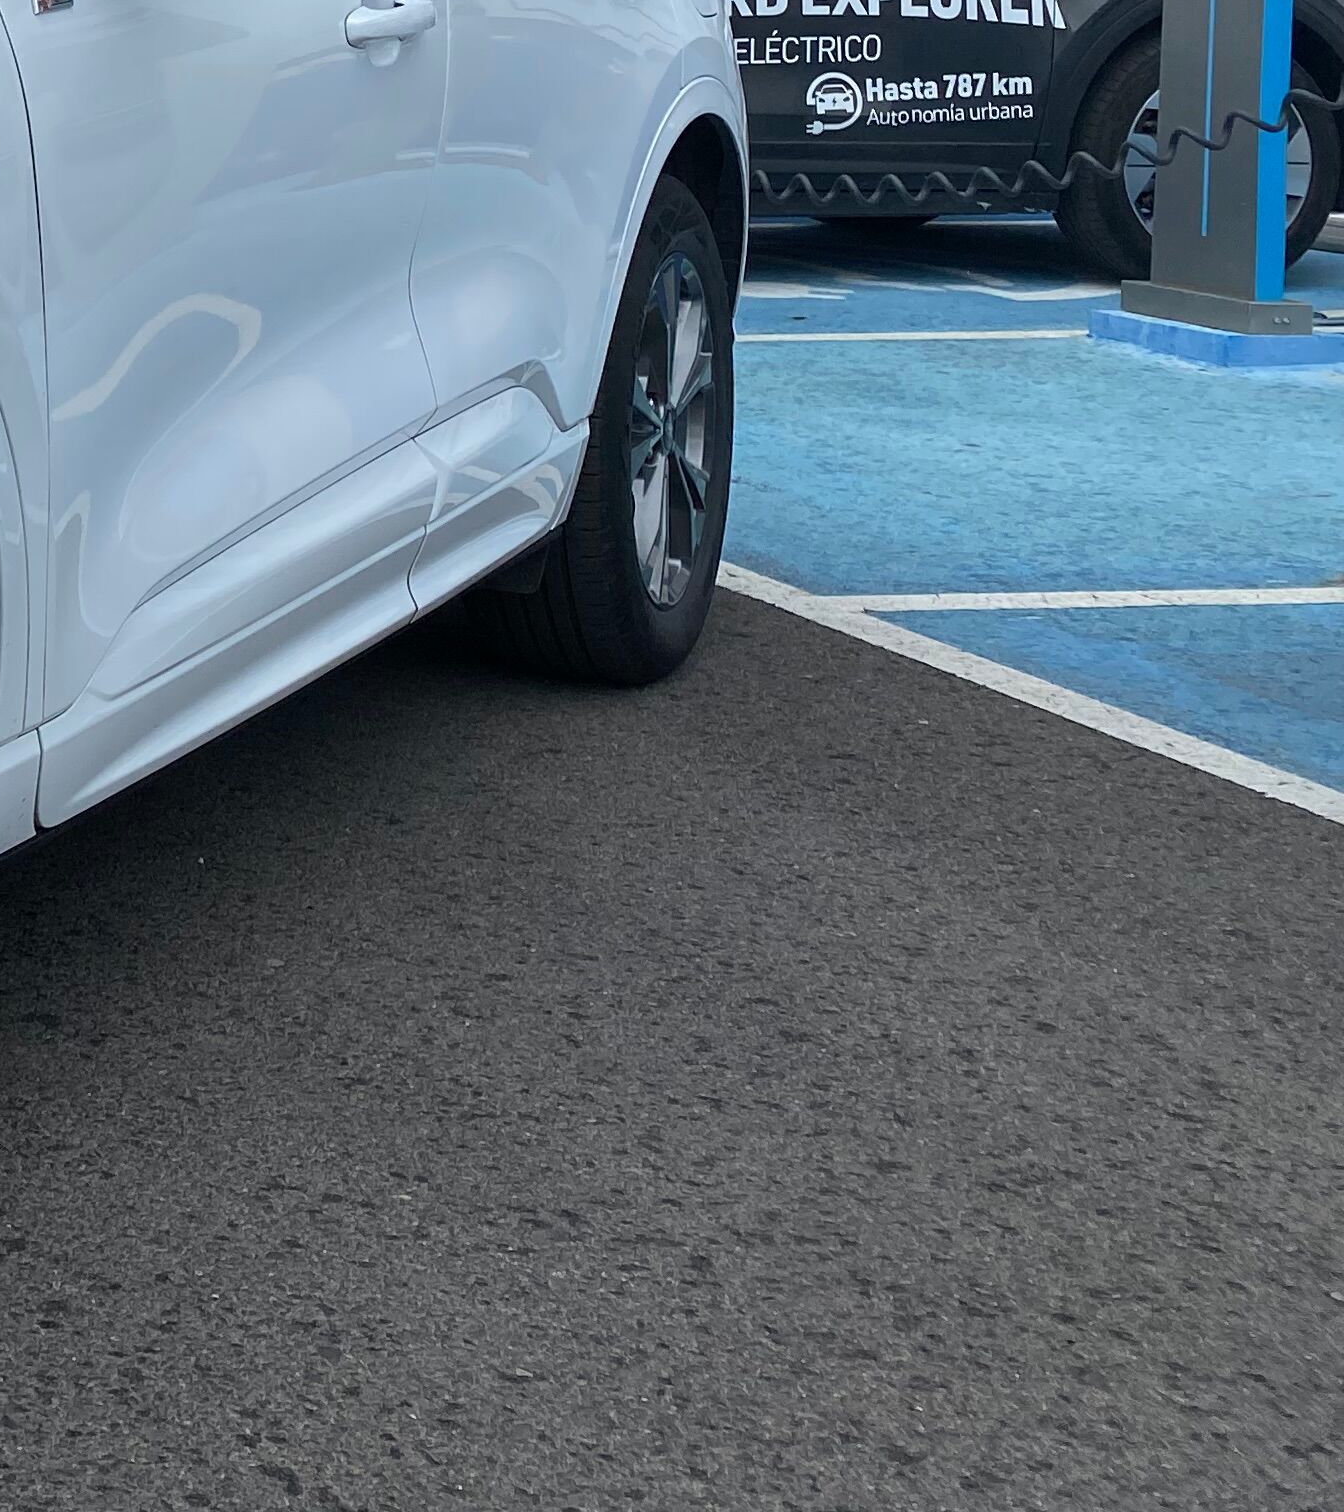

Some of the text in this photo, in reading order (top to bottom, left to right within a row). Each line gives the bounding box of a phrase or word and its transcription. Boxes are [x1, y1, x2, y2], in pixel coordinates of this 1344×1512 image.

[735, 29, 882, 66] ELÉCTRICO
[865, 72, 1033, 104] Hasta 787 km
[969, 101, 1034, 122] urbana
